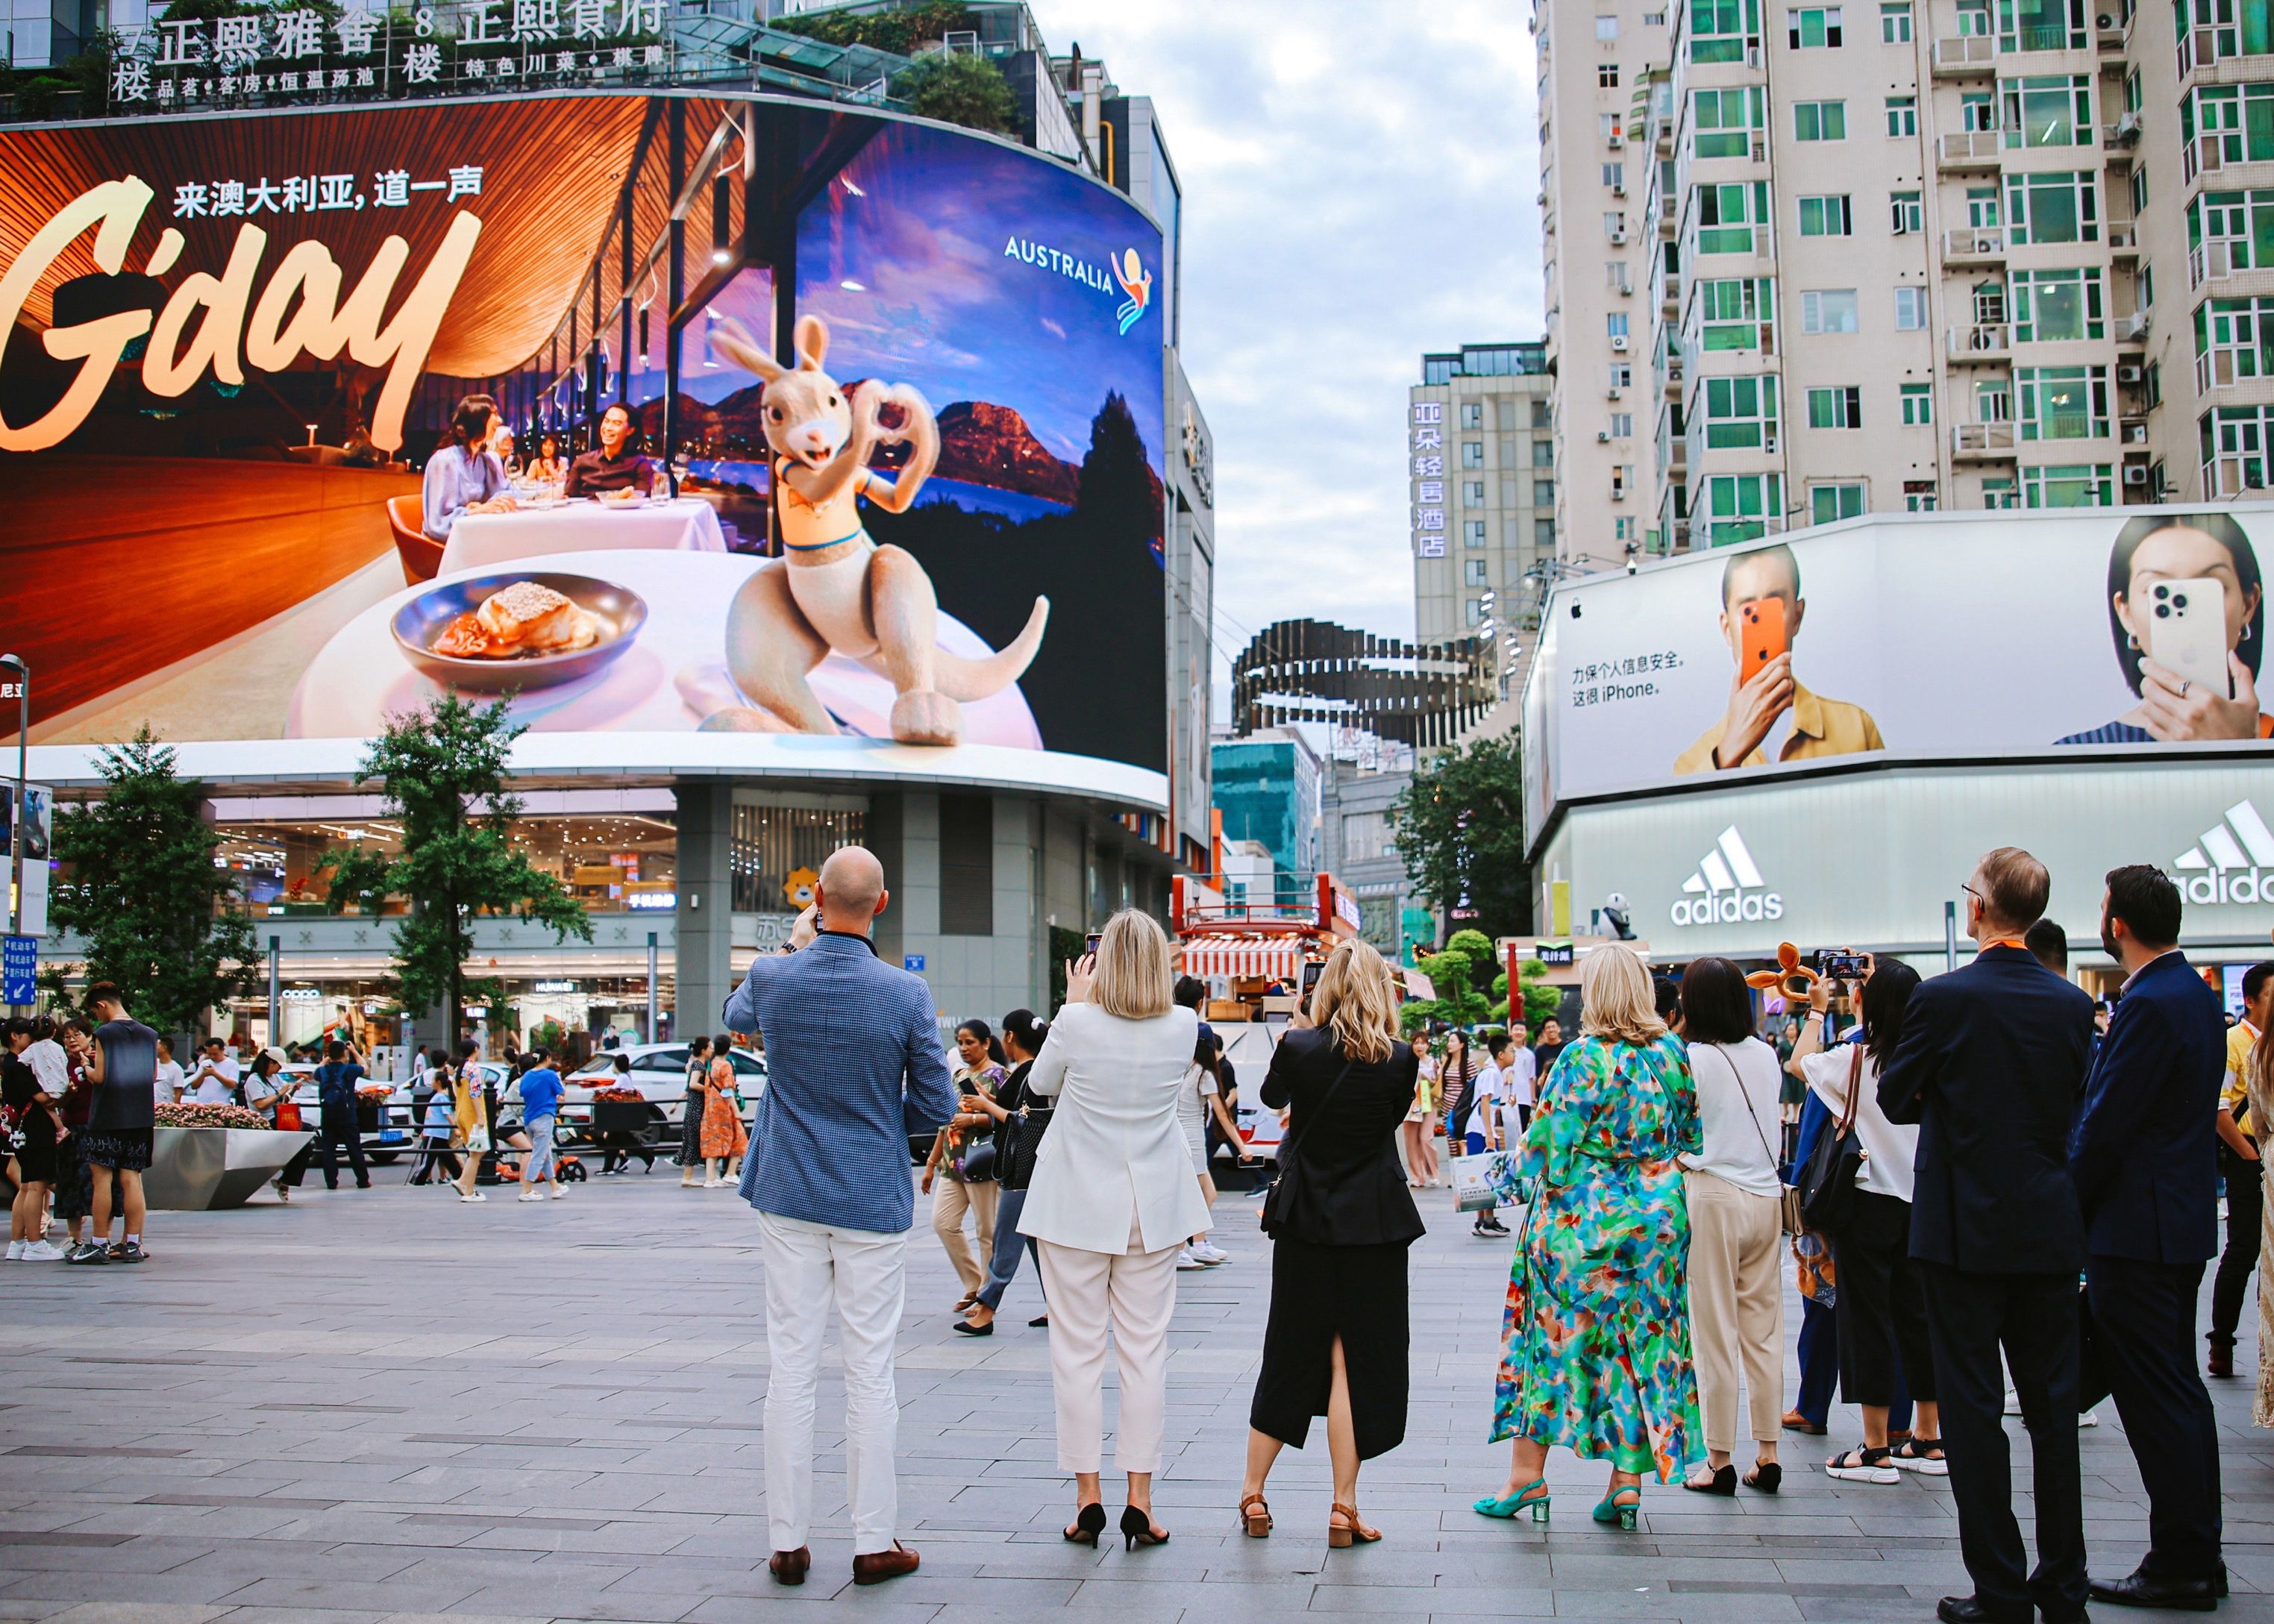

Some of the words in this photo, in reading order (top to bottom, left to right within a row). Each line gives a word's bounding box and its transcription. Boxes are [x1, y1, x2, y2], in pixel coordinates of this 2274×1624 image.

[154, 5, 382, 66] 正熙雅舍
[1004, 236, 1114, 295] AUSTRALIA
[0, 175, 483, 452] G'day
[1415, 403, 1445, 558] 亚朵轻居酒店
[1572, 650, 1684, 684] 力保个人信息安全。
[1670, 886, 1784, 927] adidas
[535, 982, 574, 993] HUAWEI
